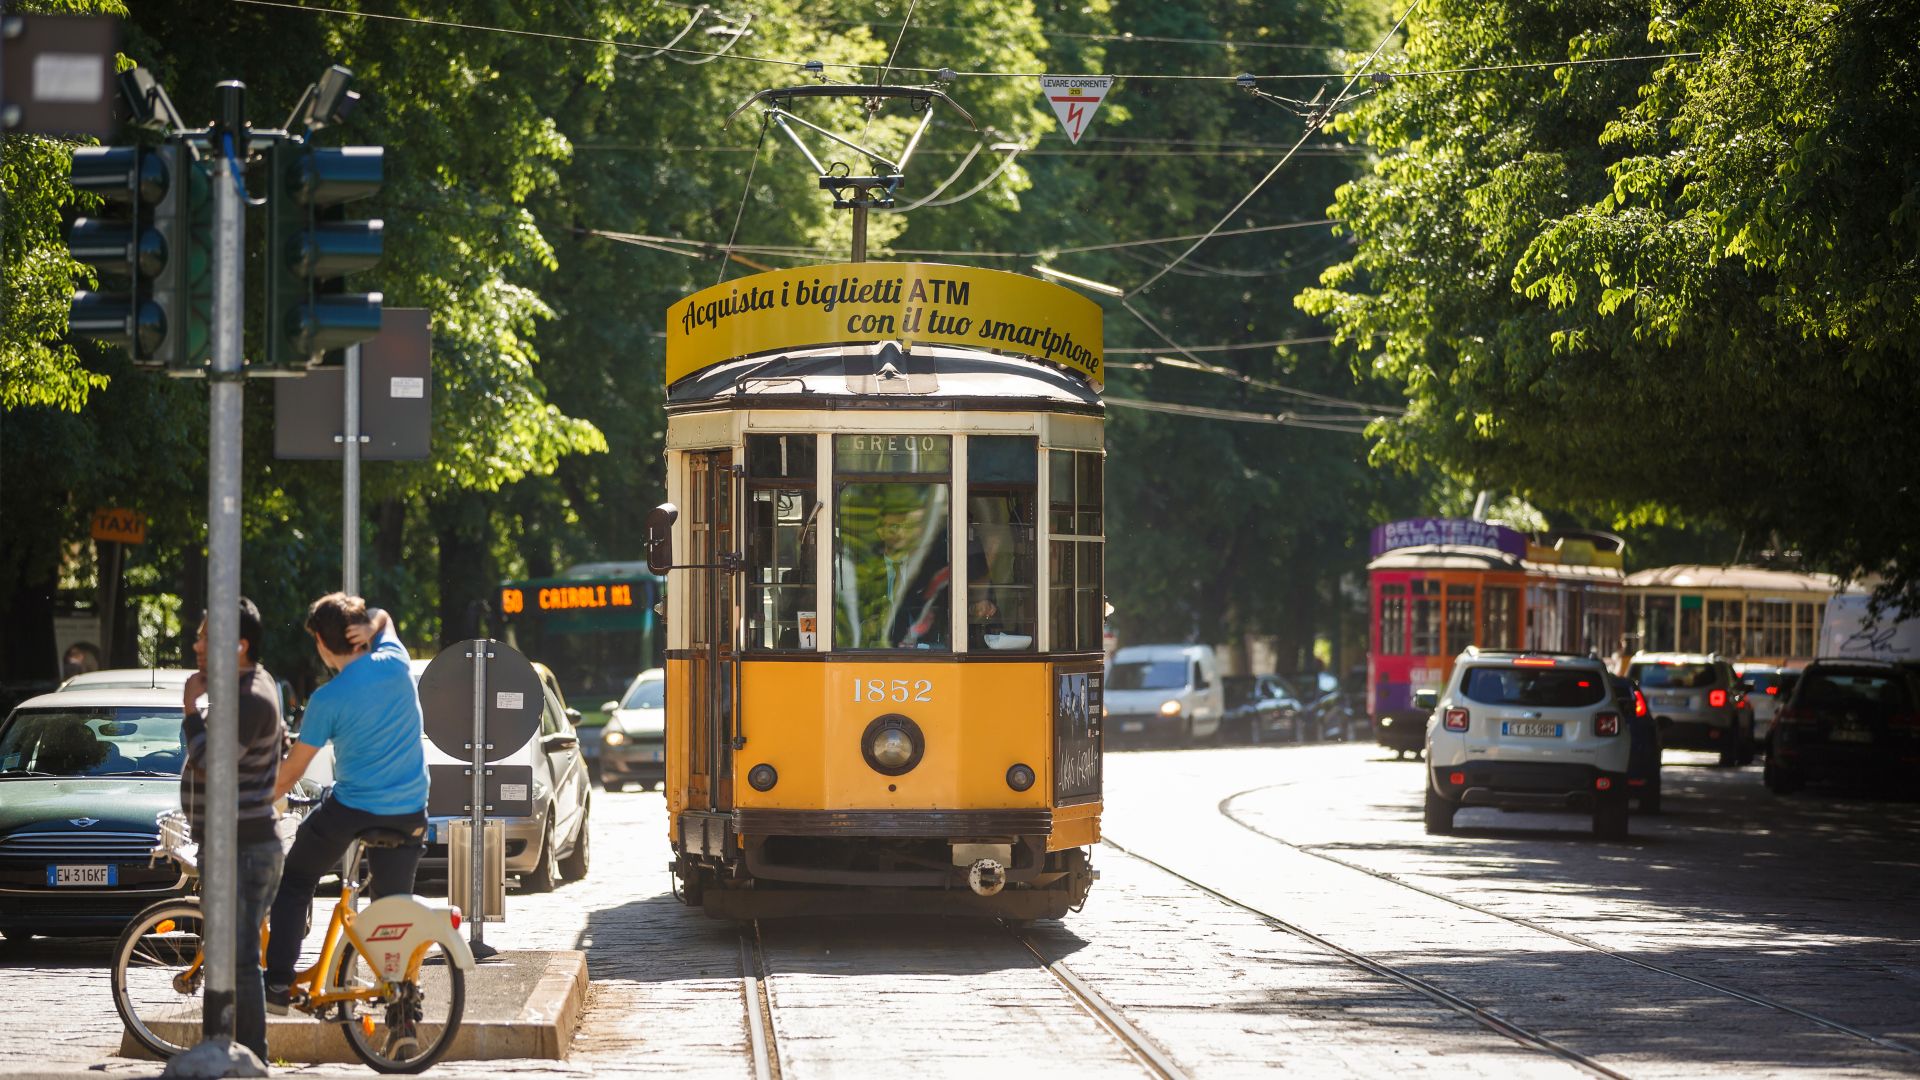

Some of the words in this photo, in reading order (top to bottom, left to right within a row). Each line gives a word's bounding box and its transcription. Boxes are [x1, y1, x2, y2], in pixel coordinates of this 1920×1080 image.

[1043, 79, 1070, 88] LEVARE
[1070, 79, 1108, 88] CORRENTE
[682, 286, 775, 336] Acquista
[780, 280, 790, 308] i
[796, 277, 904, 313] biglietti
[908, 279, 970, 306] ATM
[847, 312, 896, 335] con
[902, 307, 923, 334] il
[927, 309, 974, 337] tuo
[978, 319, 1100, 375] smartphone
[853, 435, 935, 452] GRECO
[97, 515, 143, 534] TAXI
[1385, 519, 1500, 537] GELATERIA
[1385, 533, 1500, 549] MARGHERA
[538, 585, 608, 610] CAIROLI
[805, 619, 812, 632] 2
[854, 678, 933, 703] 1852
